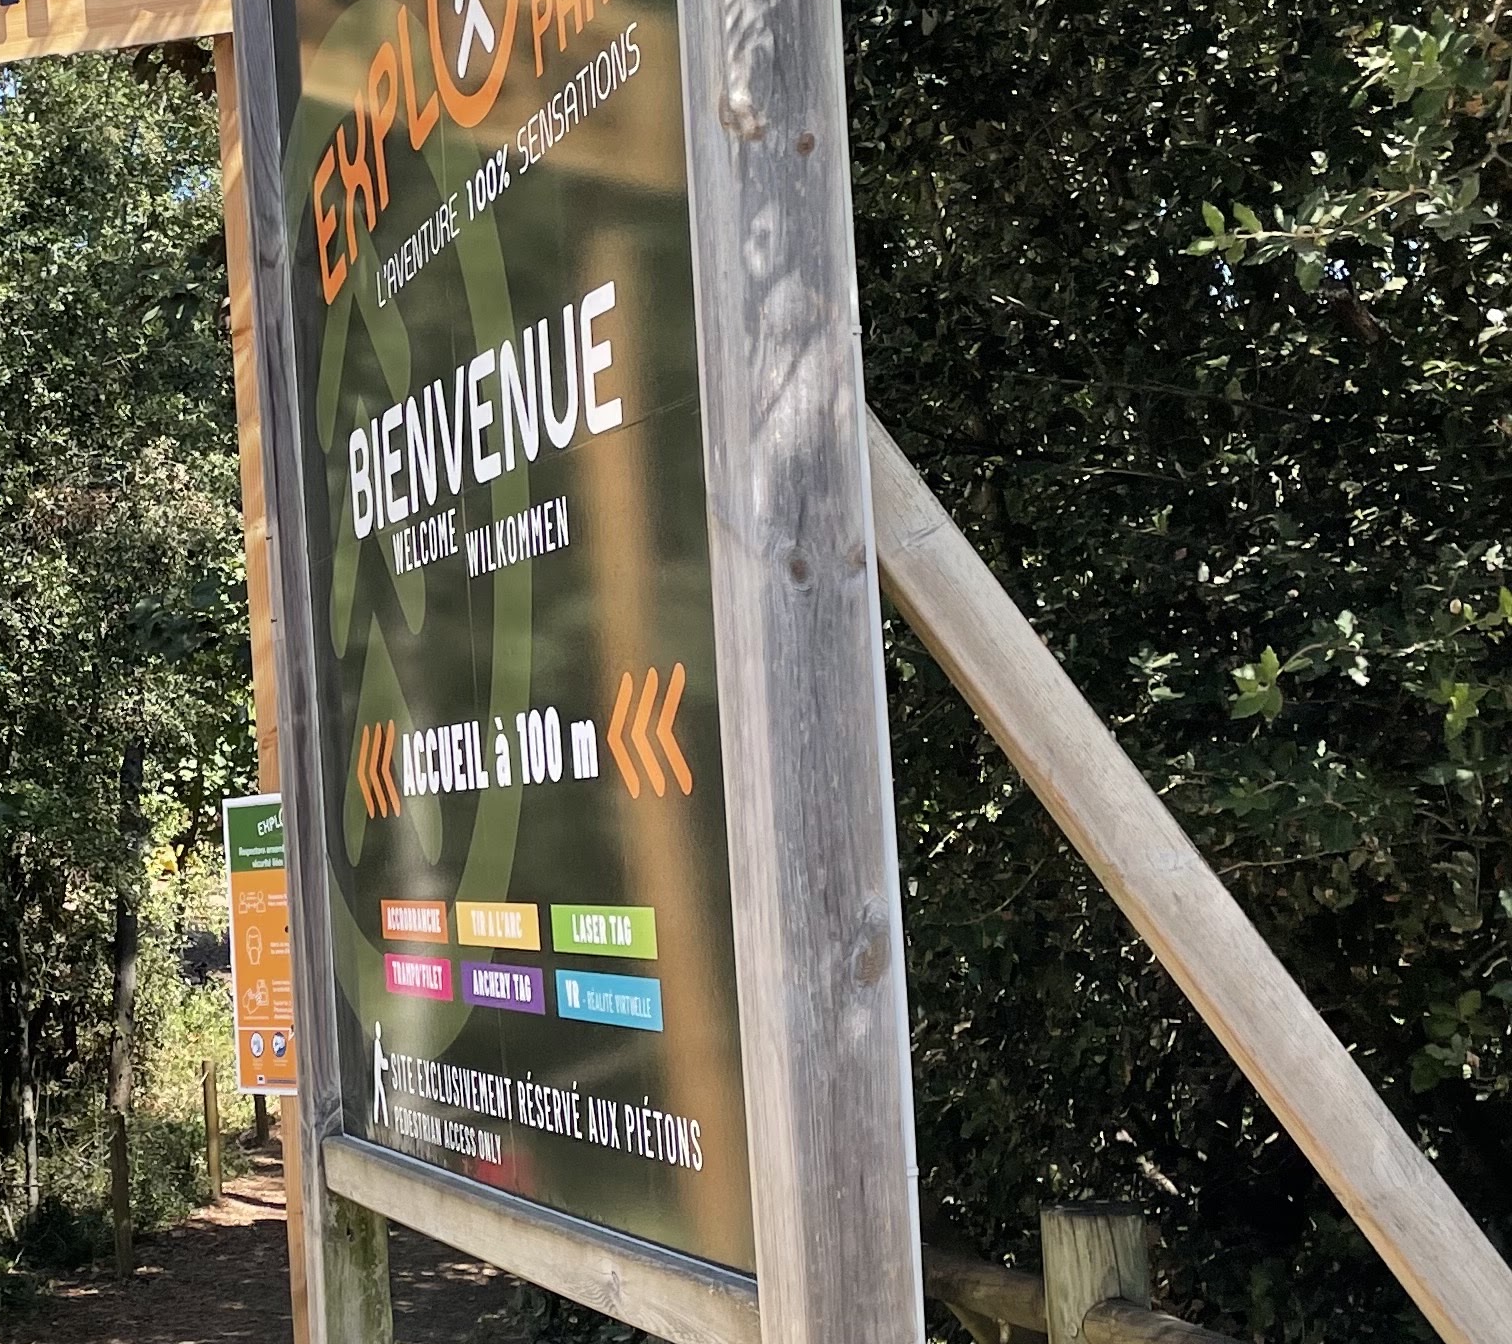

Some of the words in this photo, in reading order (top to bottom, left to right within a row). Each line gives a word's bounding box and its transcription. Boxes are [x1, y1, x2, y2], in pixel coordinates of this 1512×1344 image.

[376, 193, 460, 308] L'AVENTURE
[466, 144, 511, 221] 100%
[516, 22, 640, 174] SENSATIONS
[348, 281, 623, 540] BIENVENUE
[392, 508, 459, 575] WELCOME
[465, 496, 570, 578] WILKOMMEN
[402, 720, 489, 796] ACCUEIL
[494, 716, 512, 787] à
[516, 706, 563, 785] 100
[570, 719, 599, 779] m
[571, 913, 606, 945] LASER
[609, 914, 632, 946] TAG
[473, 969, 511, 1000] ARCHERY
[512, 973, 532, 1003] TAG
[565, 979, 581, 1008] VR
[390, 1052, 414, 1095] SITE
[416, 1059, 513, 1121] EXCLUSIVEMENT
[517, 1071, 583, 1140] RÉSERVÉ
[588, 1096, 620, 1150] AUX
[624, 1096, 703, 1172] PIÉTONS
[394, 1105, 442, 1146] PEDESTRIAN
[443, 1119, 477, 1158] ACCESS
[478, 1129, 502, 1165] ONLY
